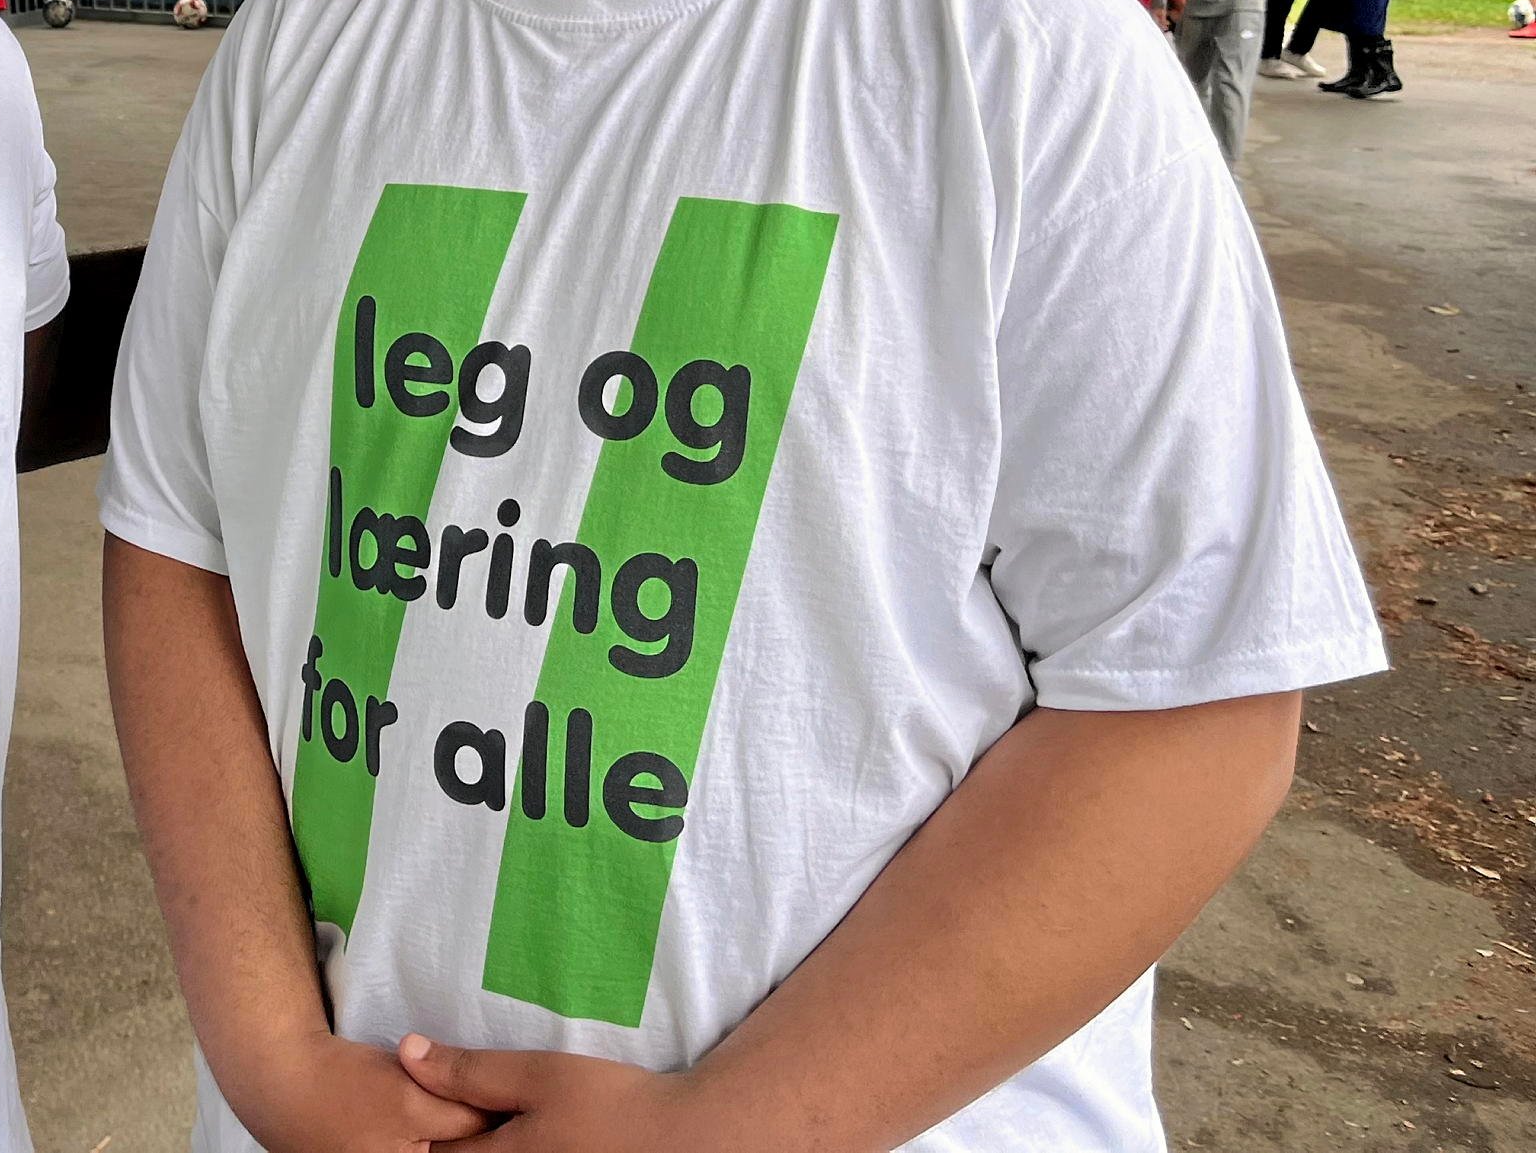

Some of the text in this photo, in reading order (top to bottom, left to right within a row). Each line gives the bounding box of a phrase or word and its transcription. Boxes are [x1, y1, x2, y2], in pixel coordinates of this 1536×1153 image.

[355, 295, 753, 486] leg og
[328, 465, 700, 680] læring
[301, 634, 690, 845] for alle
